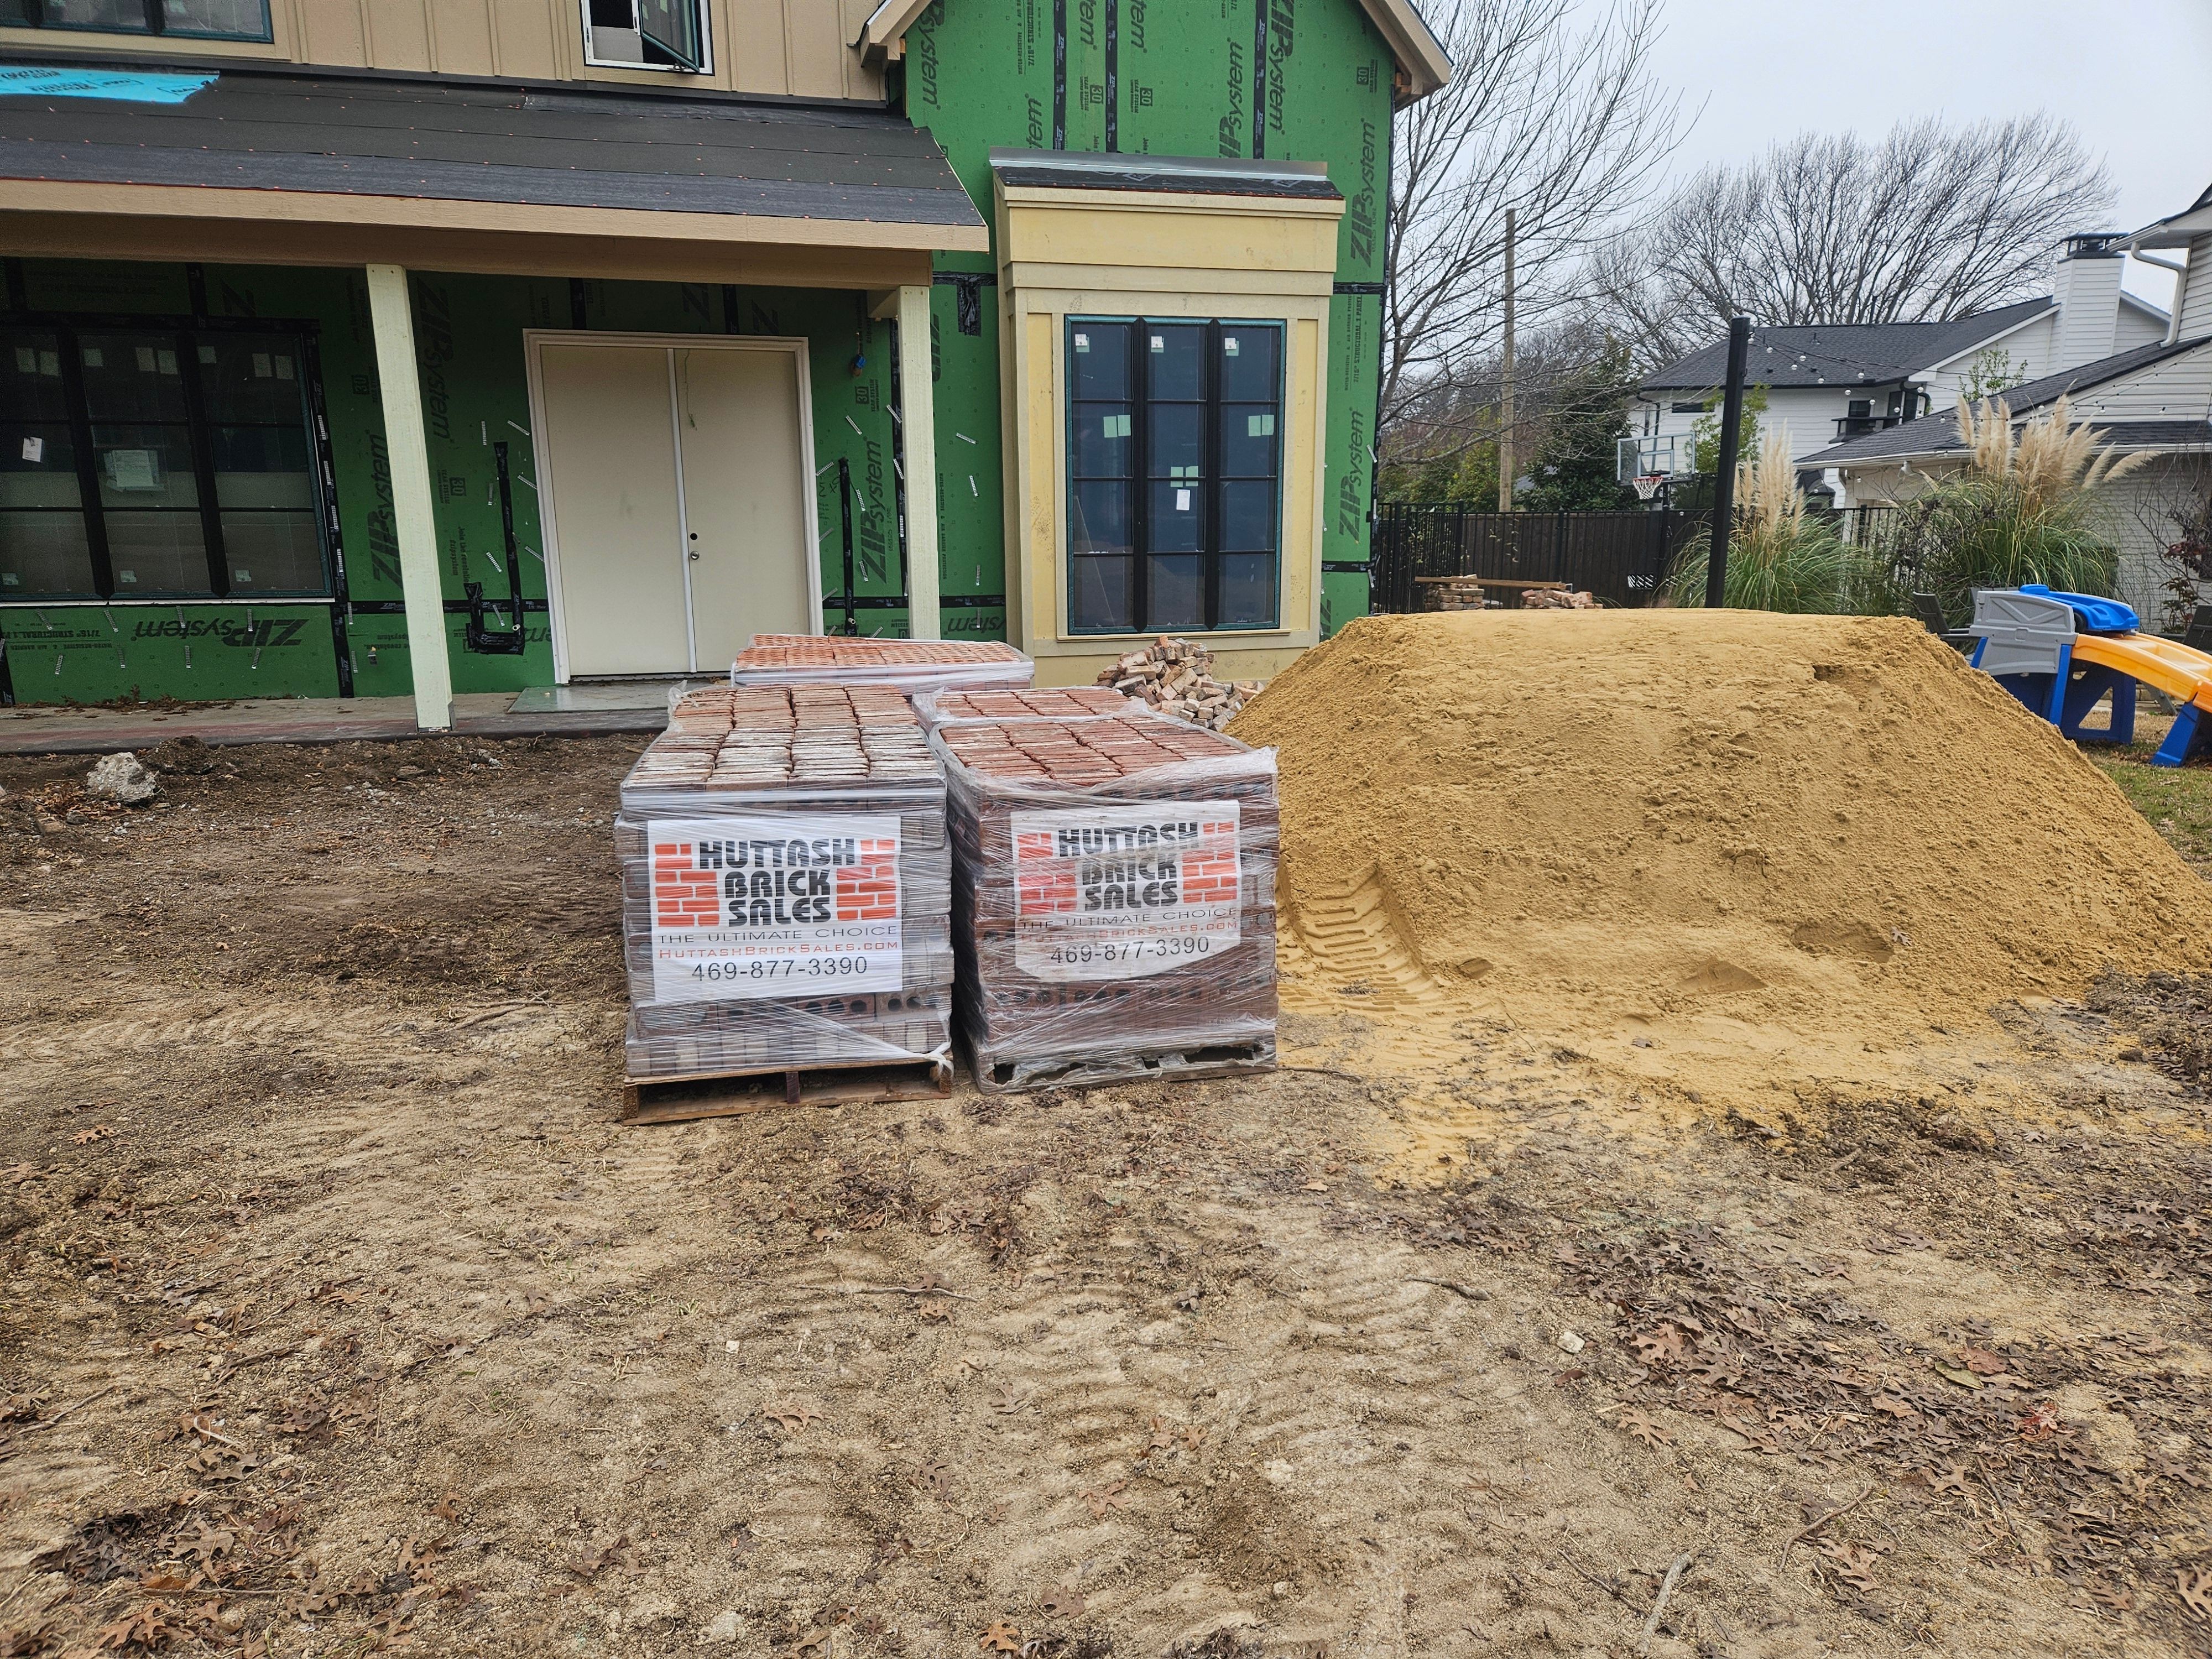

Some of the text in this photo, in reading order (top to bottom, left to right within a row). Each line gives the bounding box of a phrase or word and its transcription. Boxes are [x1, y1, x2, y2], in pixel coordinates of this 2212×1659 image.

[1357, 67, 1369, 84] 30
[1091, 86, 1103, 103] 30
[1141, 88, 1152, 106] 30
[1219, 41, 1244, 158] IPsystem
[1351, 120, 1375, 268] ZIPsystem
[855, 387, 869, 404] 30
[451, 478, 465, 495] 30
[1339, 408, 1364, 542] ZIPsystem
[860, 438, 887, 584] ZIPsystem
[135, 618, 309, 646] ZIPsystem
[700, 838, 855, 869] HUTTASH
[1058, 822, 1199, 857] HUTTASH
[1082, 852, 1177, 885] BRICK
[725, 869, 831, 899] BRICK
[1085, 880, 1178, 911] SALES
[728, 896, 831, 927] SALES
[1066, 912, 1150, 926] ULTIMATE
[1163, 907, 1237, 920] CHOICE
[659, 926, 897, 943] THE ULTIMATE CHOICE
[1051, 936, 1210, 964] 469-877-3390
[692, 956, 868, 982] 469-877-3390
